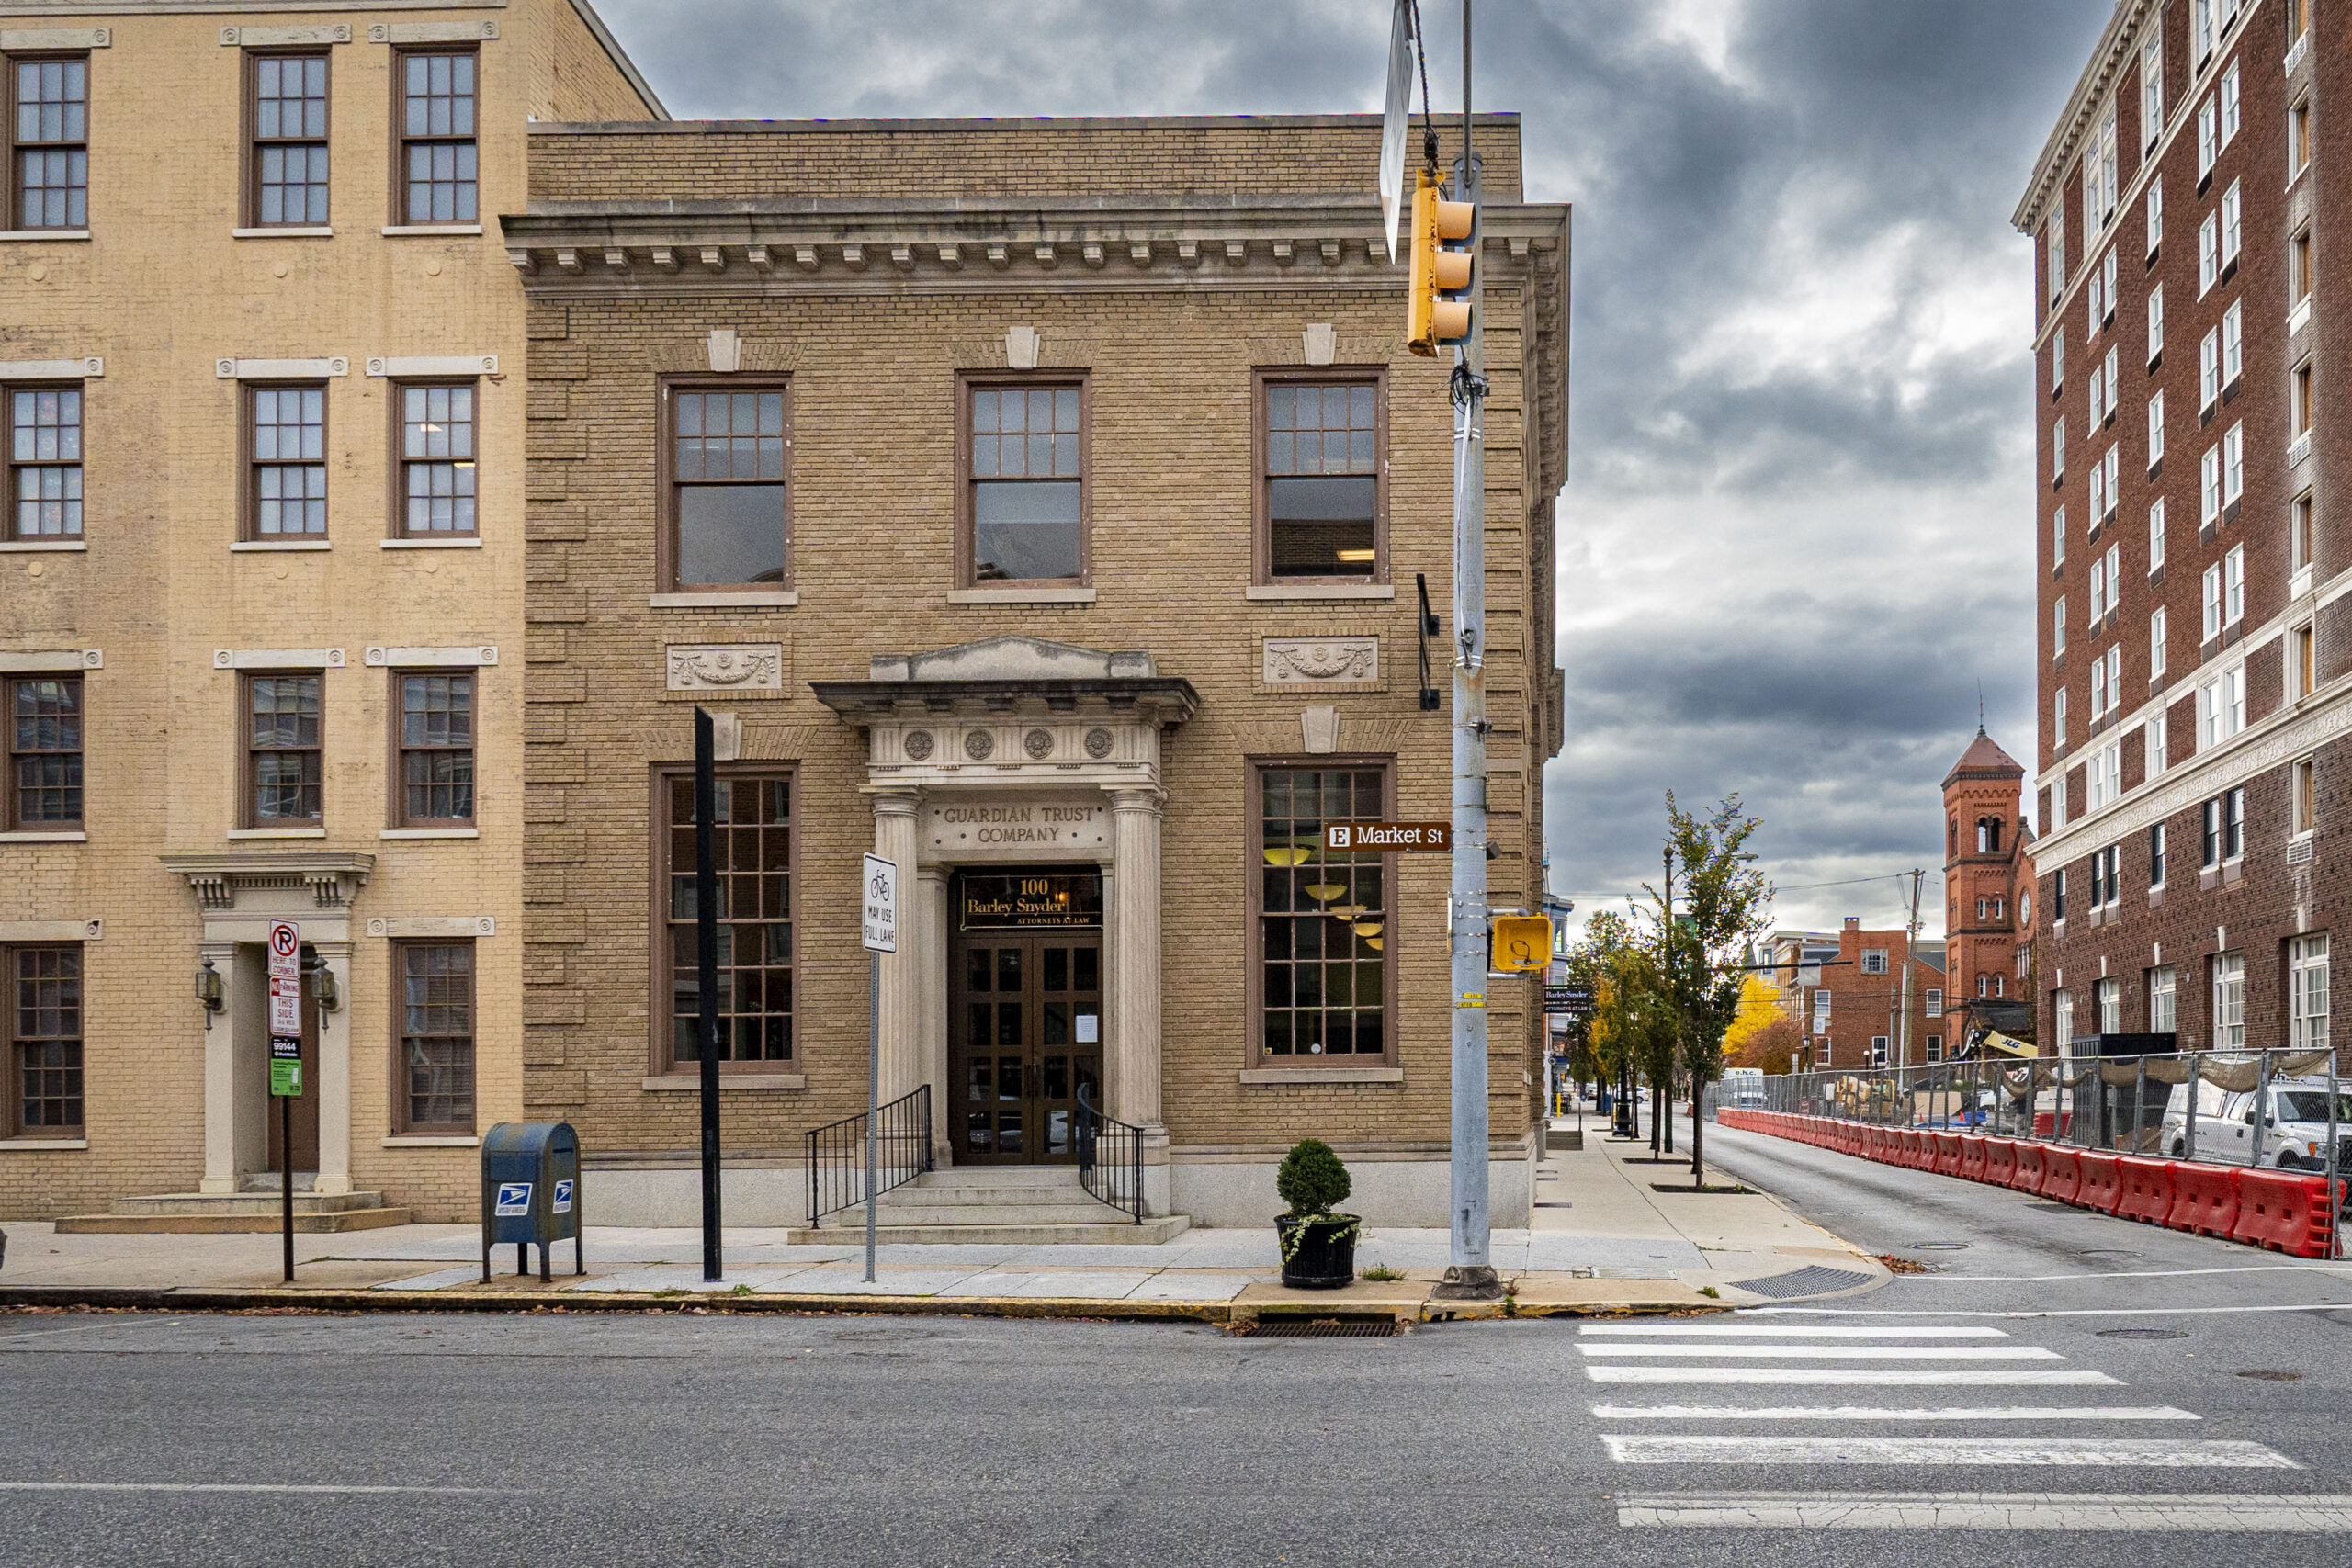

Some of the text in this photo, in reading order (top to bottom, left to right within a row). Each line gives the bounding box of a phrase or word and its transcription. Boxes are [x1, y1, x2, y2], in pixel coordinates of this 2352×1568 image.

[944, 807, 1094, 823] GUARDIAN TRUST
[978, 828, 1060, 842] COMPANY
[1333, 826, 1443, 845] E Market St
[1021, 879, 1049, 895] 100
[967, 897, 1065, 917] Barley Snyder
[868, 905, 892, 923] MAY USE
[1017, 917, 1061, 925] ATTORNEYS
[865, 924, 894, 943] FULL LANE
[272, 956, 296, 966] HERE TO
[272, 965, 295, 975] CORNER
[1545, 990, 1588, 999] Barley Snyder
[277, 998, 294, 1008] THIS
[277, 1008, 294, 1019] SIDE
[273, 1042, 297, 1051] 99144
[2001, 1038, 2021, 1049] JLG
